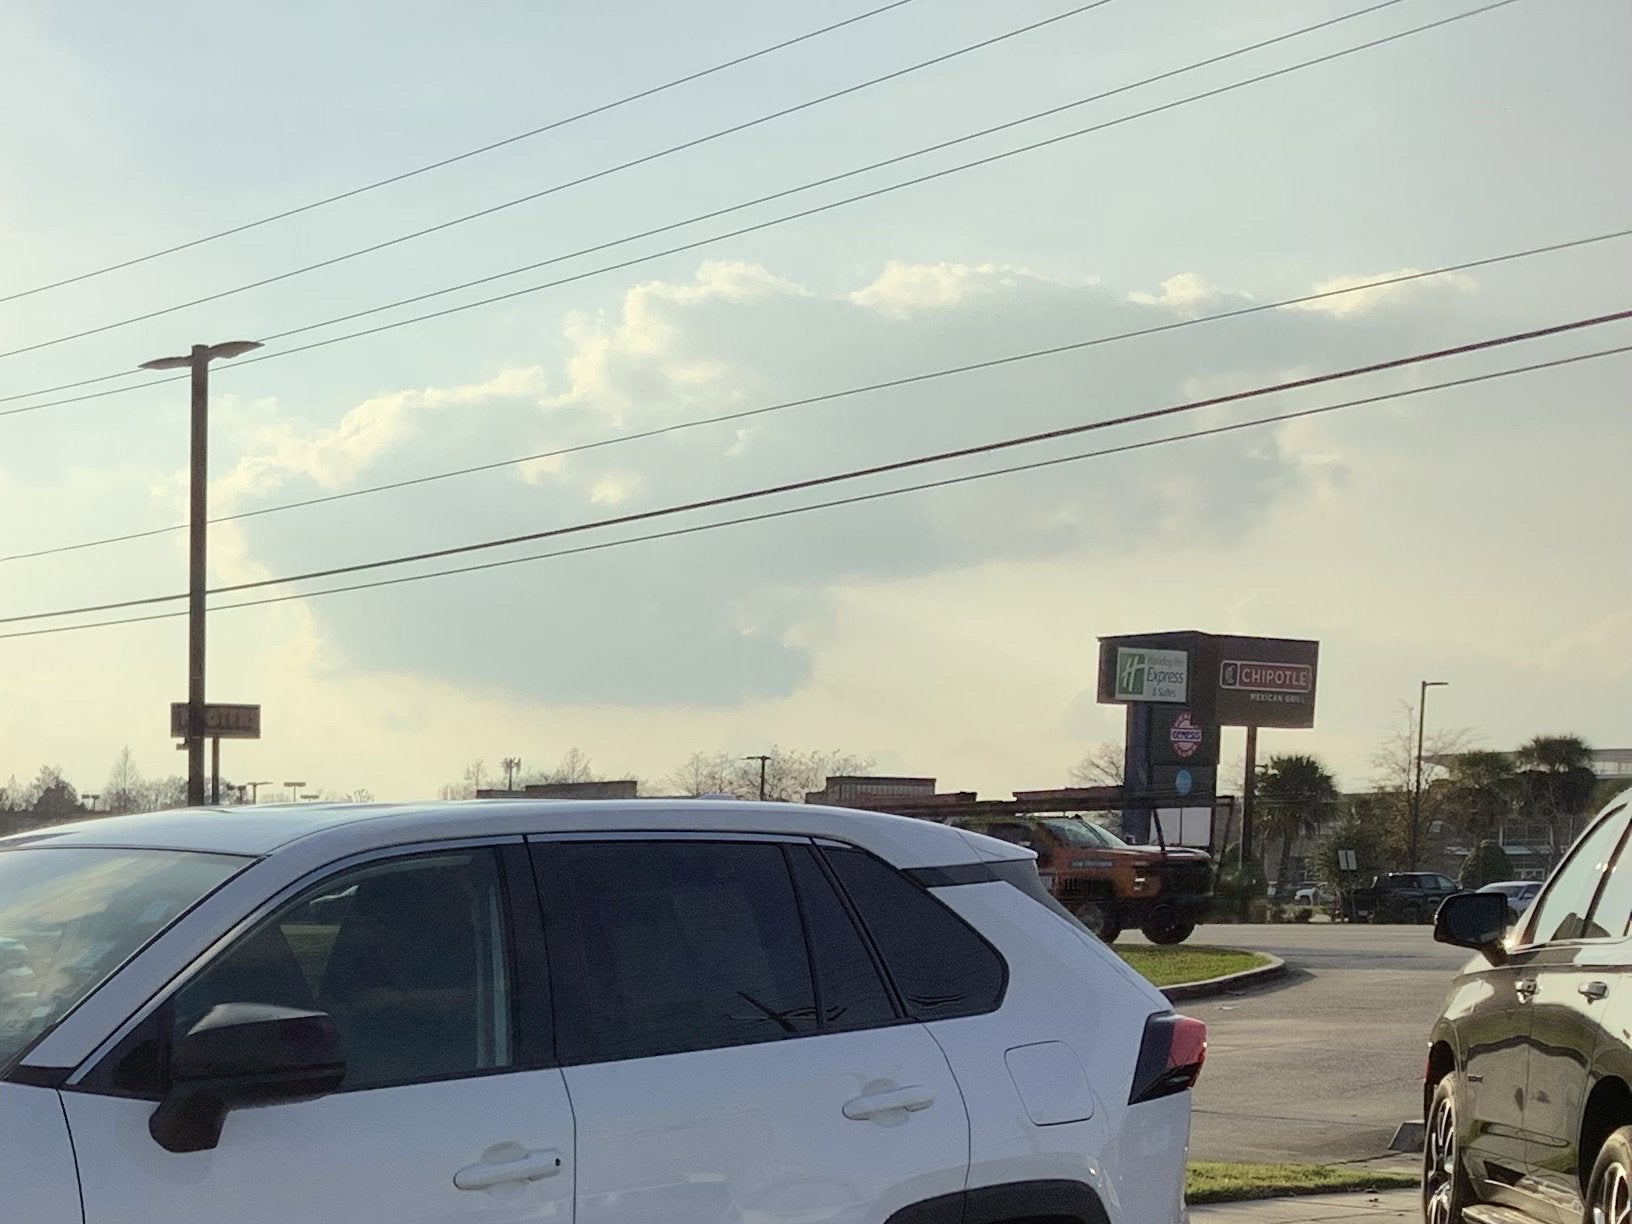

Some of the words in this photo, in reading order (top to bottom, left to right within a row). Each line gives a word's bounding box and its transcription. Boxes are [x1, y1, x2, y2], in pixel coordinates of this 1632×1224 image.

[1147, 666, 1184, 686] Express
[1241, 668, 1308, 686] CHIPOTLE
[1250, 693, 1283, 703] MEXICAN
